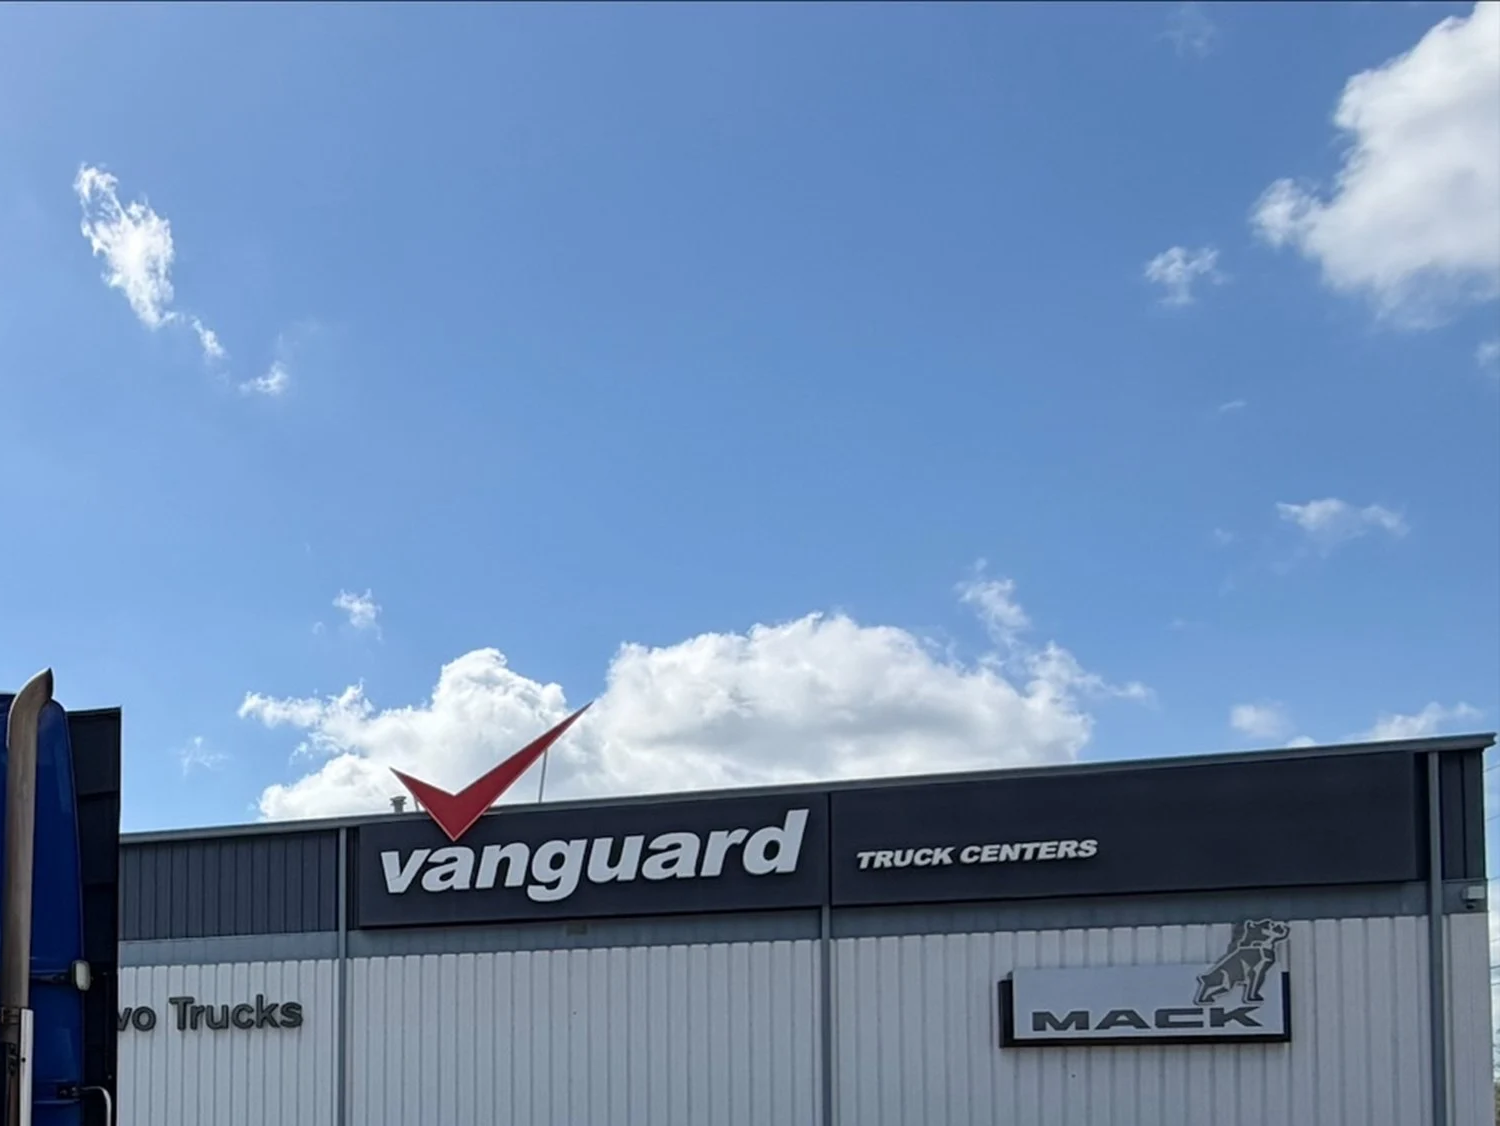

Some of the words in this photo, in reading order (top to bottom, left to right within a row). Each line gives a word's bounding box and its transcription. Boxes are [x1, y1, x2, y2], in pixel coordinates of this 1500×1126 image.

[380, 809, 809, 902] vanguard
[856, 846, 955, 869] TRUCK
[959, 839, 1098, 864] CENTERS
[168, 994, 304, 1031] Trucks
[1032, 1006, 1263, 1031] MACK
